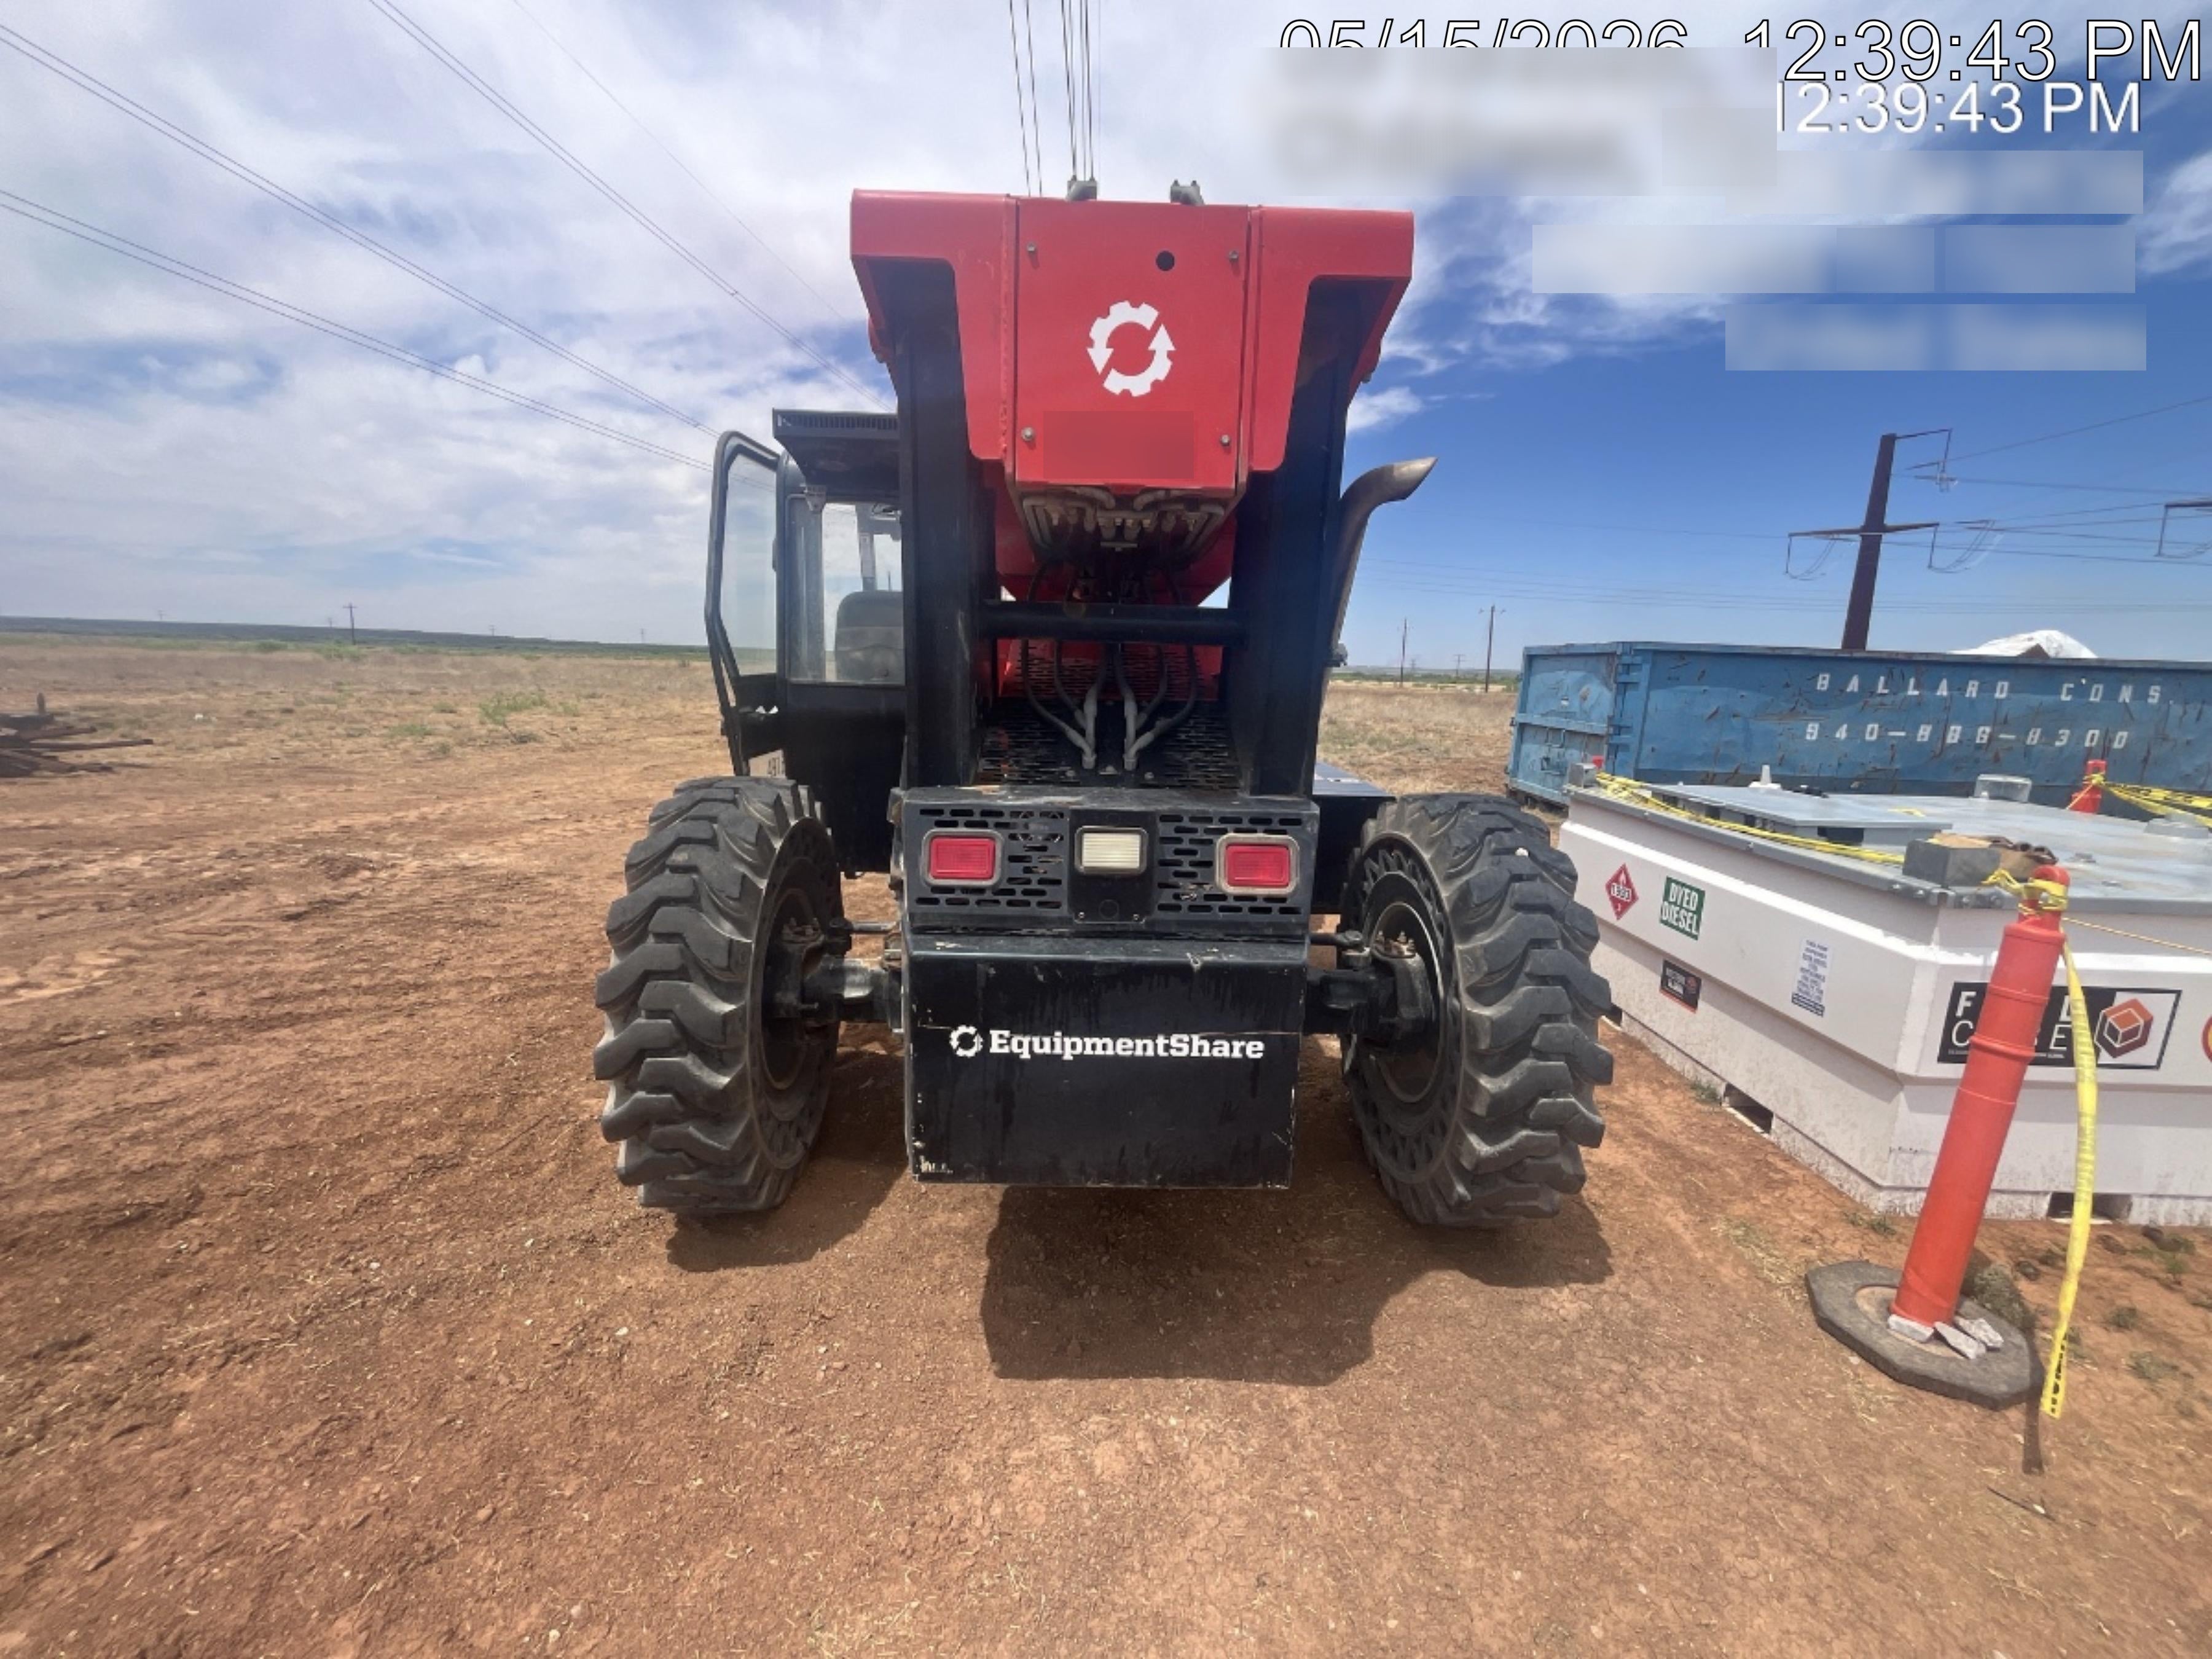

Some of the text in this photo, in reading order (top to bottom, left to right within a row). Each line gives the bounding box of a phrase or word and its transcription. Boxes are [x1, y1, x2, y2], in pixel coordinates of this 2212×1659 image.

[1817, 673, 2009, 699] BALLARD
[1669, 882, 1698, 911] DYED
[1661, 901, 1699, 935] DIESEL
[989, 1029, 1265, 1061] EquipmentShare
